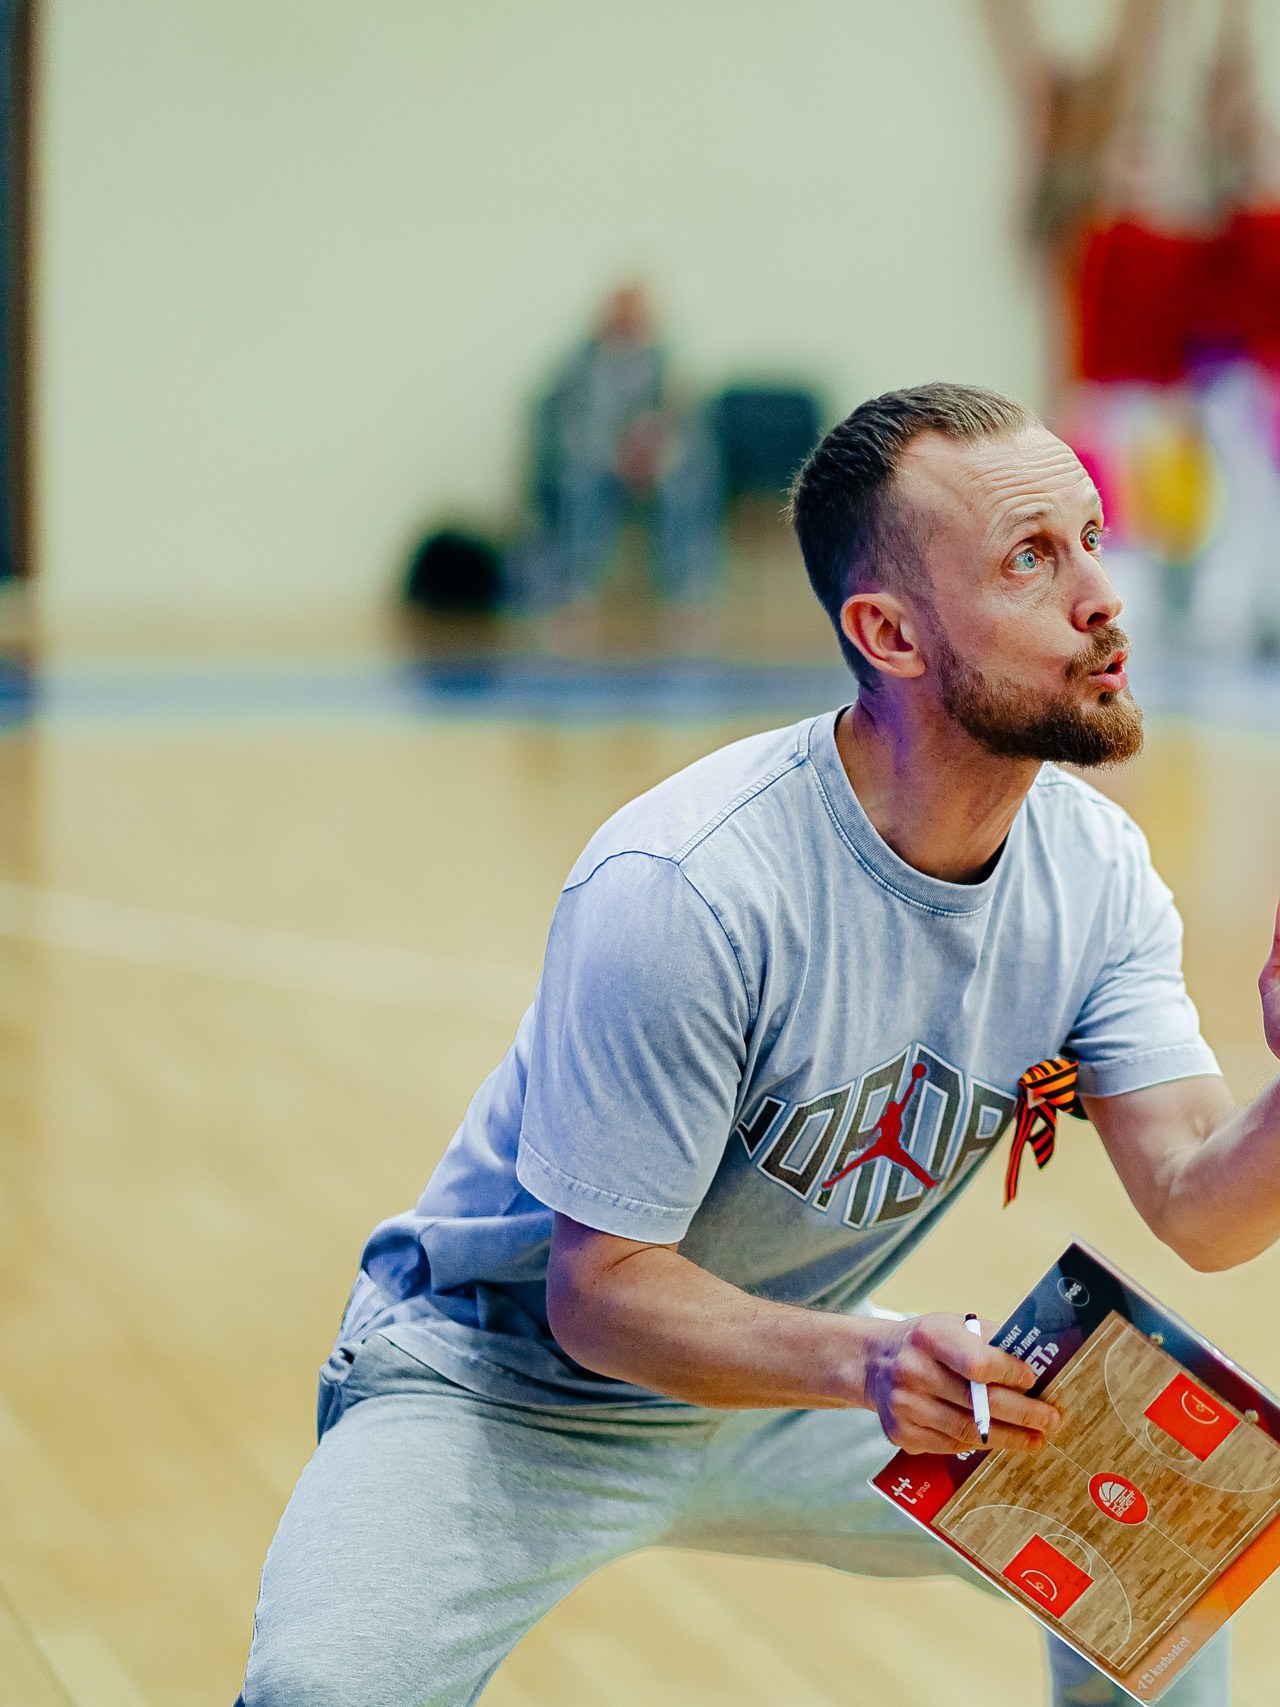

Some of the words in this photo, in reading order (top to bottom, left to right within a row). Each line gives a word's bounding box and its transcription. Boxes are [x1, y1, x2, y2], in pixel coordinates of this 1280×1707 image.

[737, 1041, 1017, 1230] JORDA
[998, 1324, 1021, 1351] ИОНАТ
[1019, 1326, 1041, 1350] ЛИГИ
